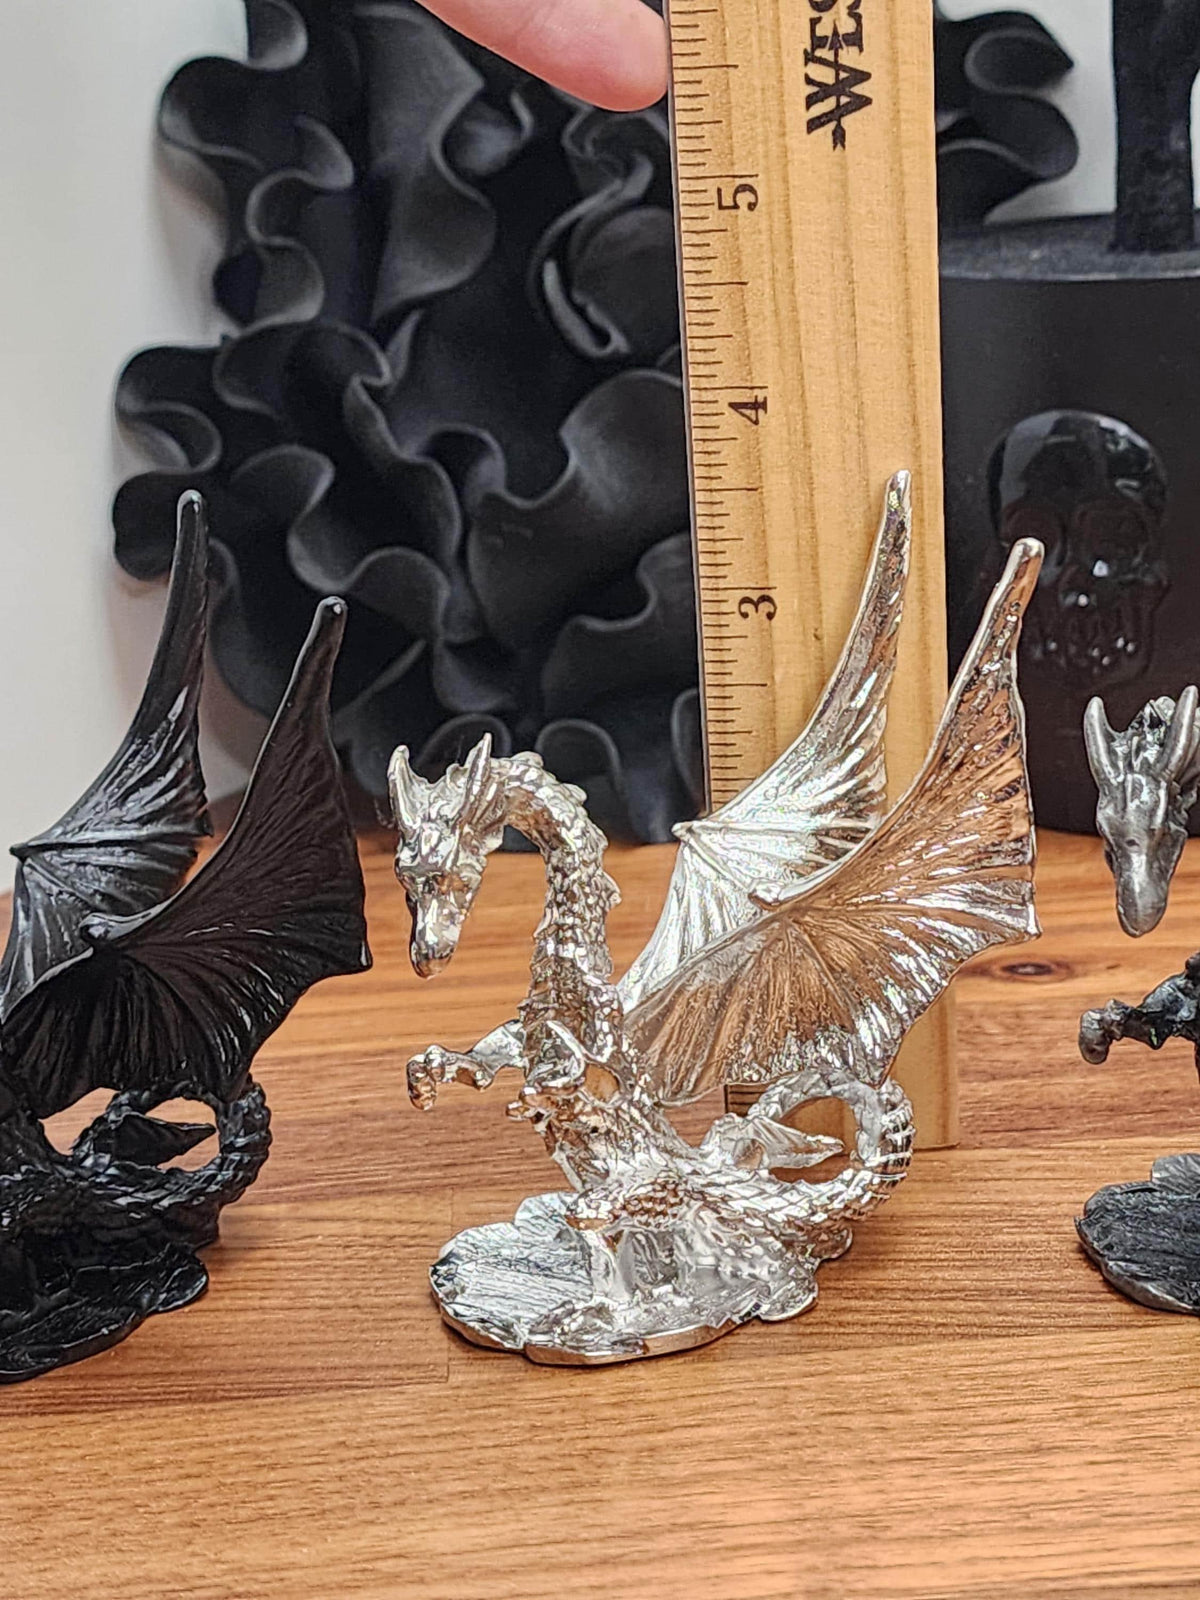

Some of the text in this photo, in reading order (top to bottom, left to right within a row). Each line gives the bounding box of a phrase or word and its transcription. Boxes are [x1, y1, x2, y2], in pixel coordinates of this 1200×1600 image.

[716, 183, 759, 212] 5
[728, 395, 768, 425] 4
[738, 594, 778, 621] 3
